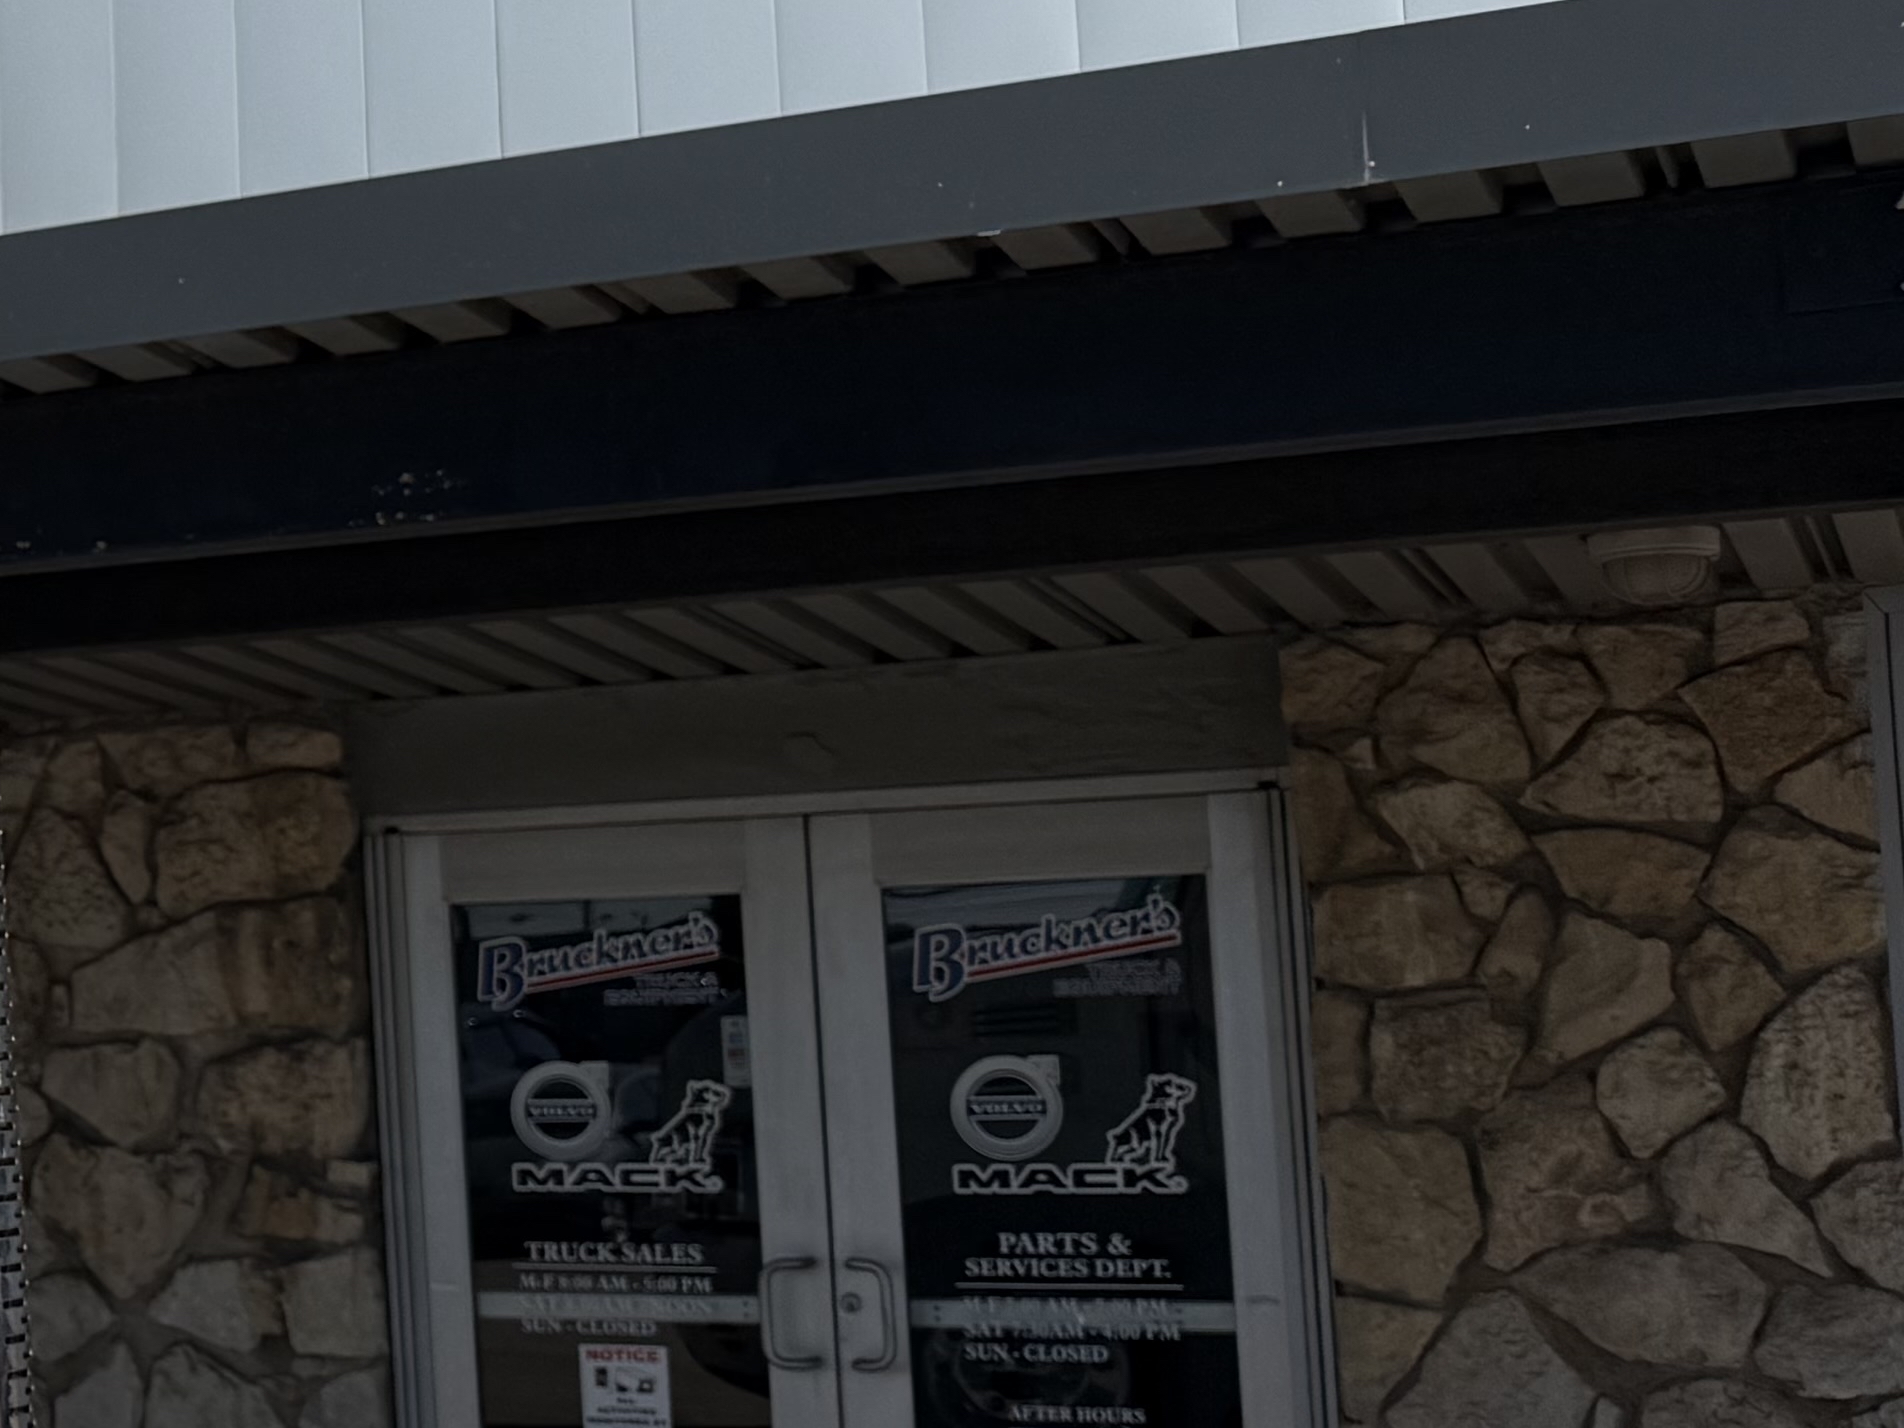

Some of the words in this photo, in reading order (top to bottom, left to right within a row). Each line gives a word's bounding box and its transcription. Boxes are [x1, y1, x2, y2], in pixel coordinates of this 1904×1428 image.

[912, 893, 1181, 1002] Bruckner's
[478, 911, 719, 1011] Bruckner's
[529, 1106, 594, 1116] VOLVO
[969, 1103, 1043, 1114] VOLVO
[512, 1162, 712, 1193] MACK
[952, 1162, 1170, 1194] MACK
[523, 1241, 617, 1262] TRUCK
[621, 1243, 705, 1265] SALES
[997, 1232, 1098, 1255] PARTS
[1106, 1232, 1133, 1256] &
[964, 1257, 1090, 1278] SERVICES
[1094, 1258, 1172, 1279] DEPT.
[596, 1274, 629, 1292] AM
[680, 1275, 713, 1293] PM
[586, 1350, 660, 1363] NOTICE
[963, 1342, 1011, 1361] SUN
[1023, 1343, 1109, 1363] CLOSED
[1009, 1404, 1073, 1423] AFTER
[1076, 1407, 1147, 1424] HOURS
